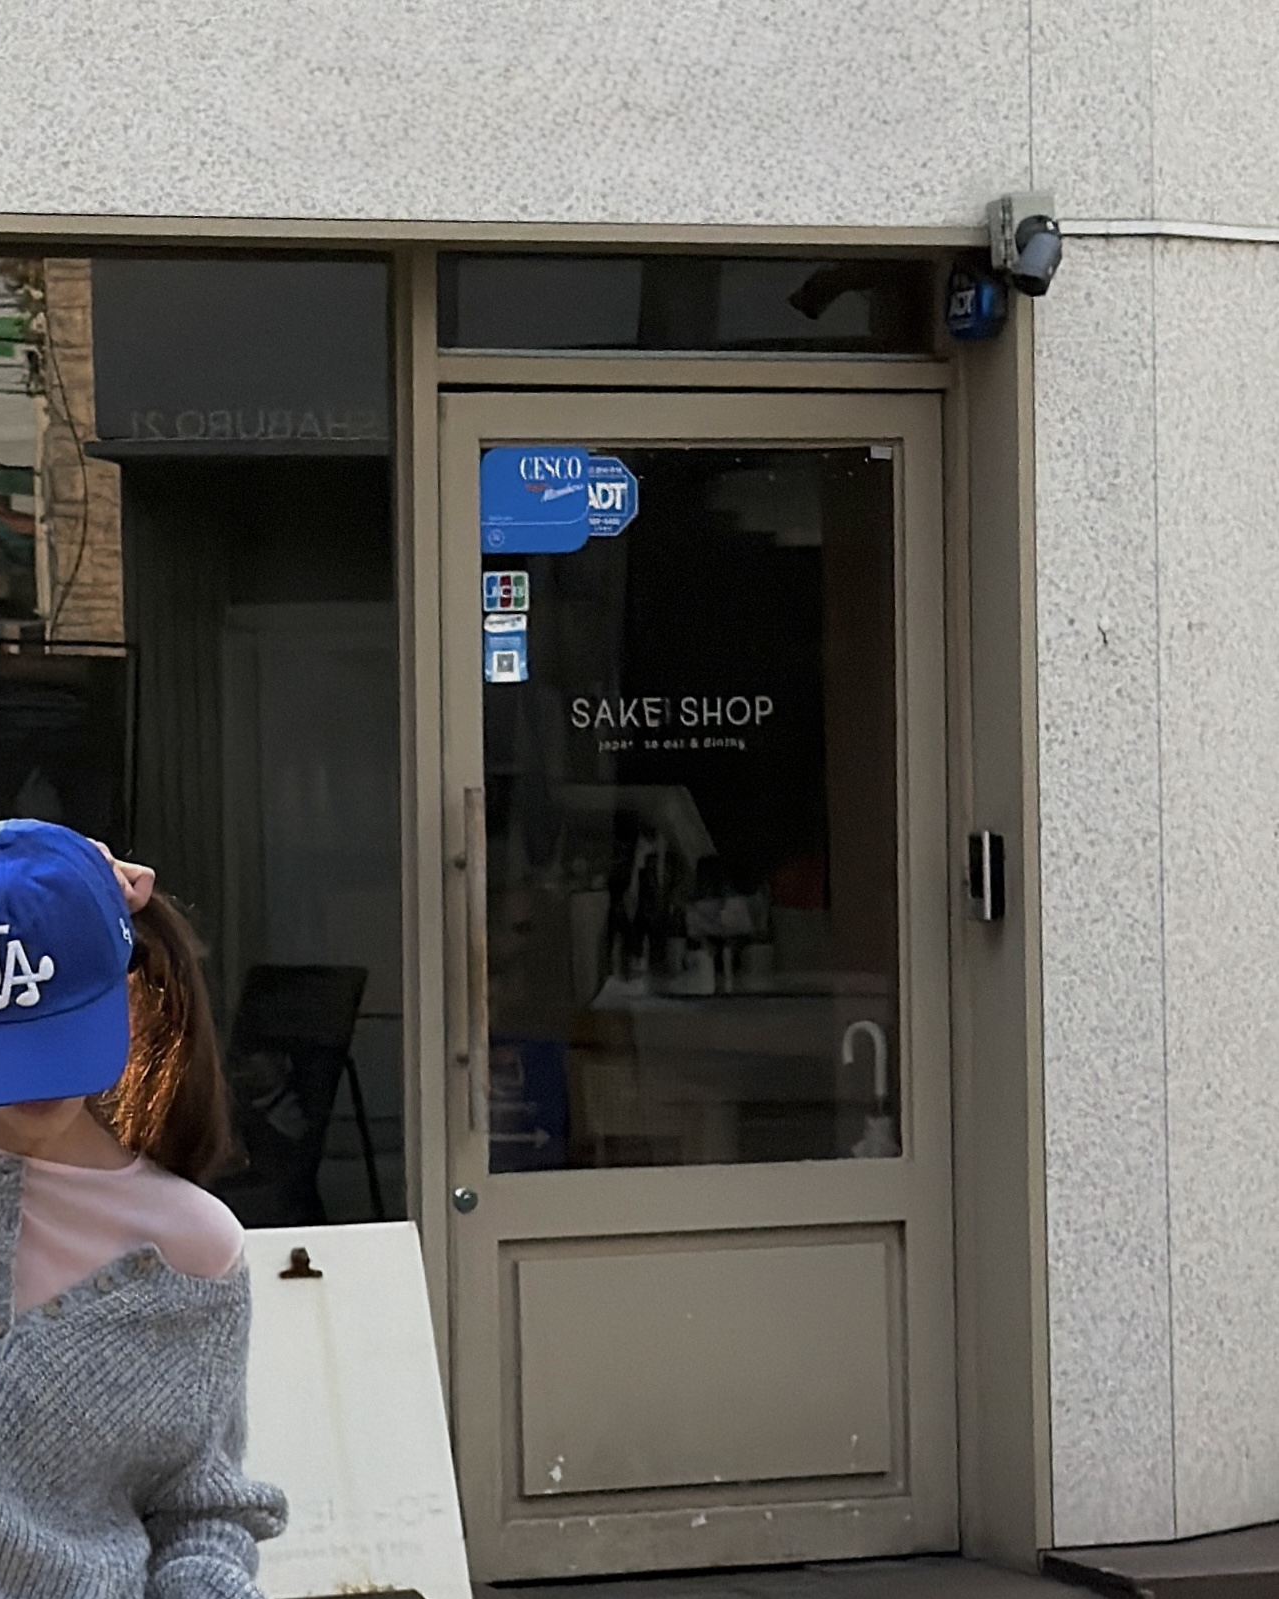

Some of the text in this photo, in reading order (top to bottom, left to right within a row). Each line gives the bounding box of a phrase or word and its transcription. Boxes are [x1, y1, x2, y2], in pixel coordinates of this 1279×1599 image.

[519, 456, 582, 480] CESCO
[572, 696, 773, 728] SAKE SHOP
